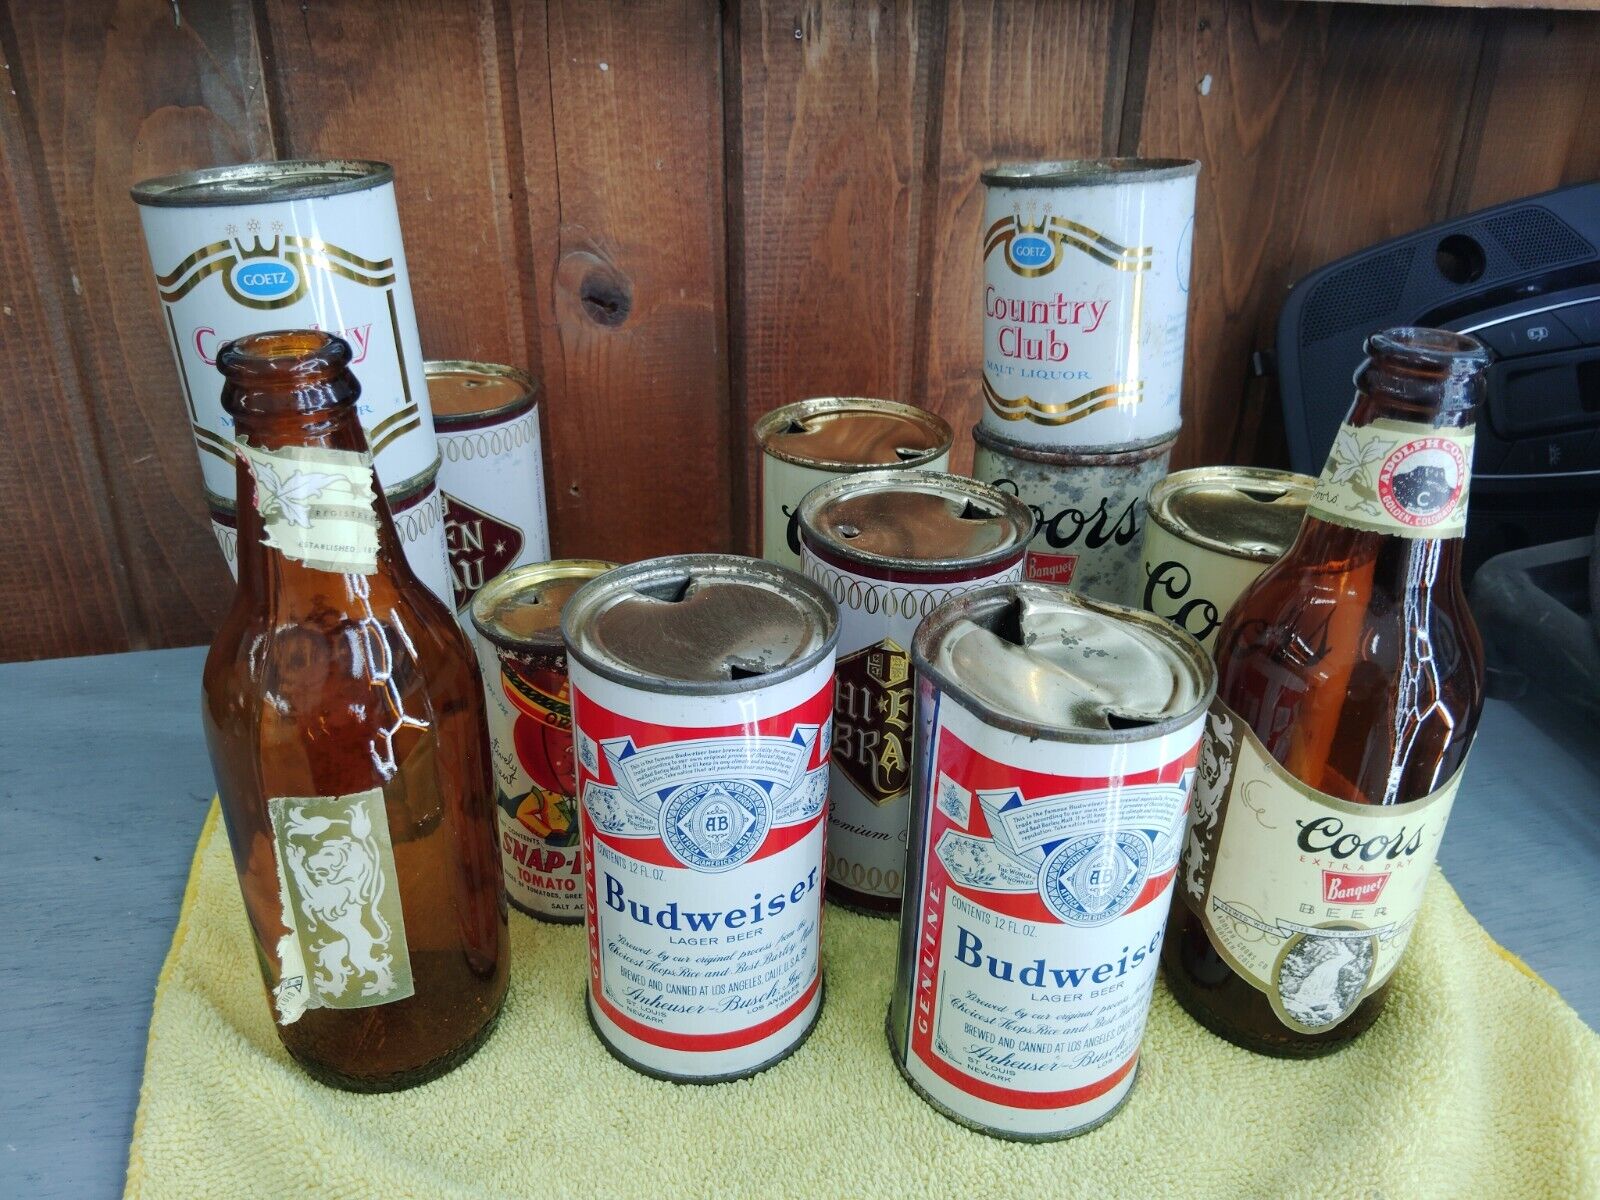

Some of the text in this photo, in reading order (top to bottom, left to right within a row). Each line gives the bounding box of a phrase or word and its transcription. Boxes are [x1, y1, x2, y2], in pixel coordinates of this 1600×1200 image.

[1016, 246, 1047, 257] GOETZ
[243, 271, 289, 287] GOETZ
[985, 284, 1111, 333] Country
[998, 326, 1070, 362] Club
[986, 360, 1092, 380] MALT LIQUOR
[1383, 438, 1440, 482] ADOLPH
[1417, 491, 1430, 507] C
[1028, 556, 1073, 581] Banquet
[675, 750, 707, 759] Budweiser
[833, 722, 909, 793] BRA
[1069, 801, 1104, 810] Budweiser
[706, 816, 729, 832] AB
[680, 834, 701, 855] AFRICA
[736, 831, 752, 850] ASIA
[1296, 817, 1425, 862] Coors
[597, 842, 626, 869] CONTENTS
[630, 861, 638, 873] 12
[1299, 855, 1414, 871] EXTRA DRY
[517, 866, 576, 891] TOMATO
[1327, 878, 1382, 901] Banquet
[604, 866, 817, 933] Budweiser
[1299, 903, 1387, 918] BEER
[952, 895, 991, 925] CONTENTS
[995, 916, 1006, 930] 12
[669, 927, 763, 946] LAGER BEER
[607, 939, 644, 968] Choicest
[704, 967, 729, 978] and
[618, 934, 651, 955] Brewed
[657, 950, 670, 962] by
[695, 951, 737, 966] original
[918, 882, 941, 1034] GENUINE
[620, 965, 646, 986] BREWED
[648, 979, 663, 992] AND
[666, 983, 697, 996] CANNED
[699, 985, 709, 996] AT
[711, 984, 726, 996] LOS
[1031, 993, 1083, 1003] LAGER
[1091, 981, 1125, 998] BEER
[626, 1006, 665, 1024] NEWARK
[640, 1005, 667, 1018] LOUIS
[747, 1004, 765, 1015] LOS
[950, 994, 997, 1025] Choicest
[1062, 1023, 1089, 1035] and
[965, 990, 1008, 1013] Brewed
[1015, 1008, 1028, 1019] by
[964, 1022, 996, 1044] BREWED
[998, 1036, 1016, 1049] AND
[1018, 1041, 1053, 1054] CANNED
[1054, 1042, 1065, 1054] AT
[1068, 1041, 1081, 1052] LOS
[967, 1064, 1012, 1083] NEWARK
[985, 1064, 1016, 1077] LOUIS
